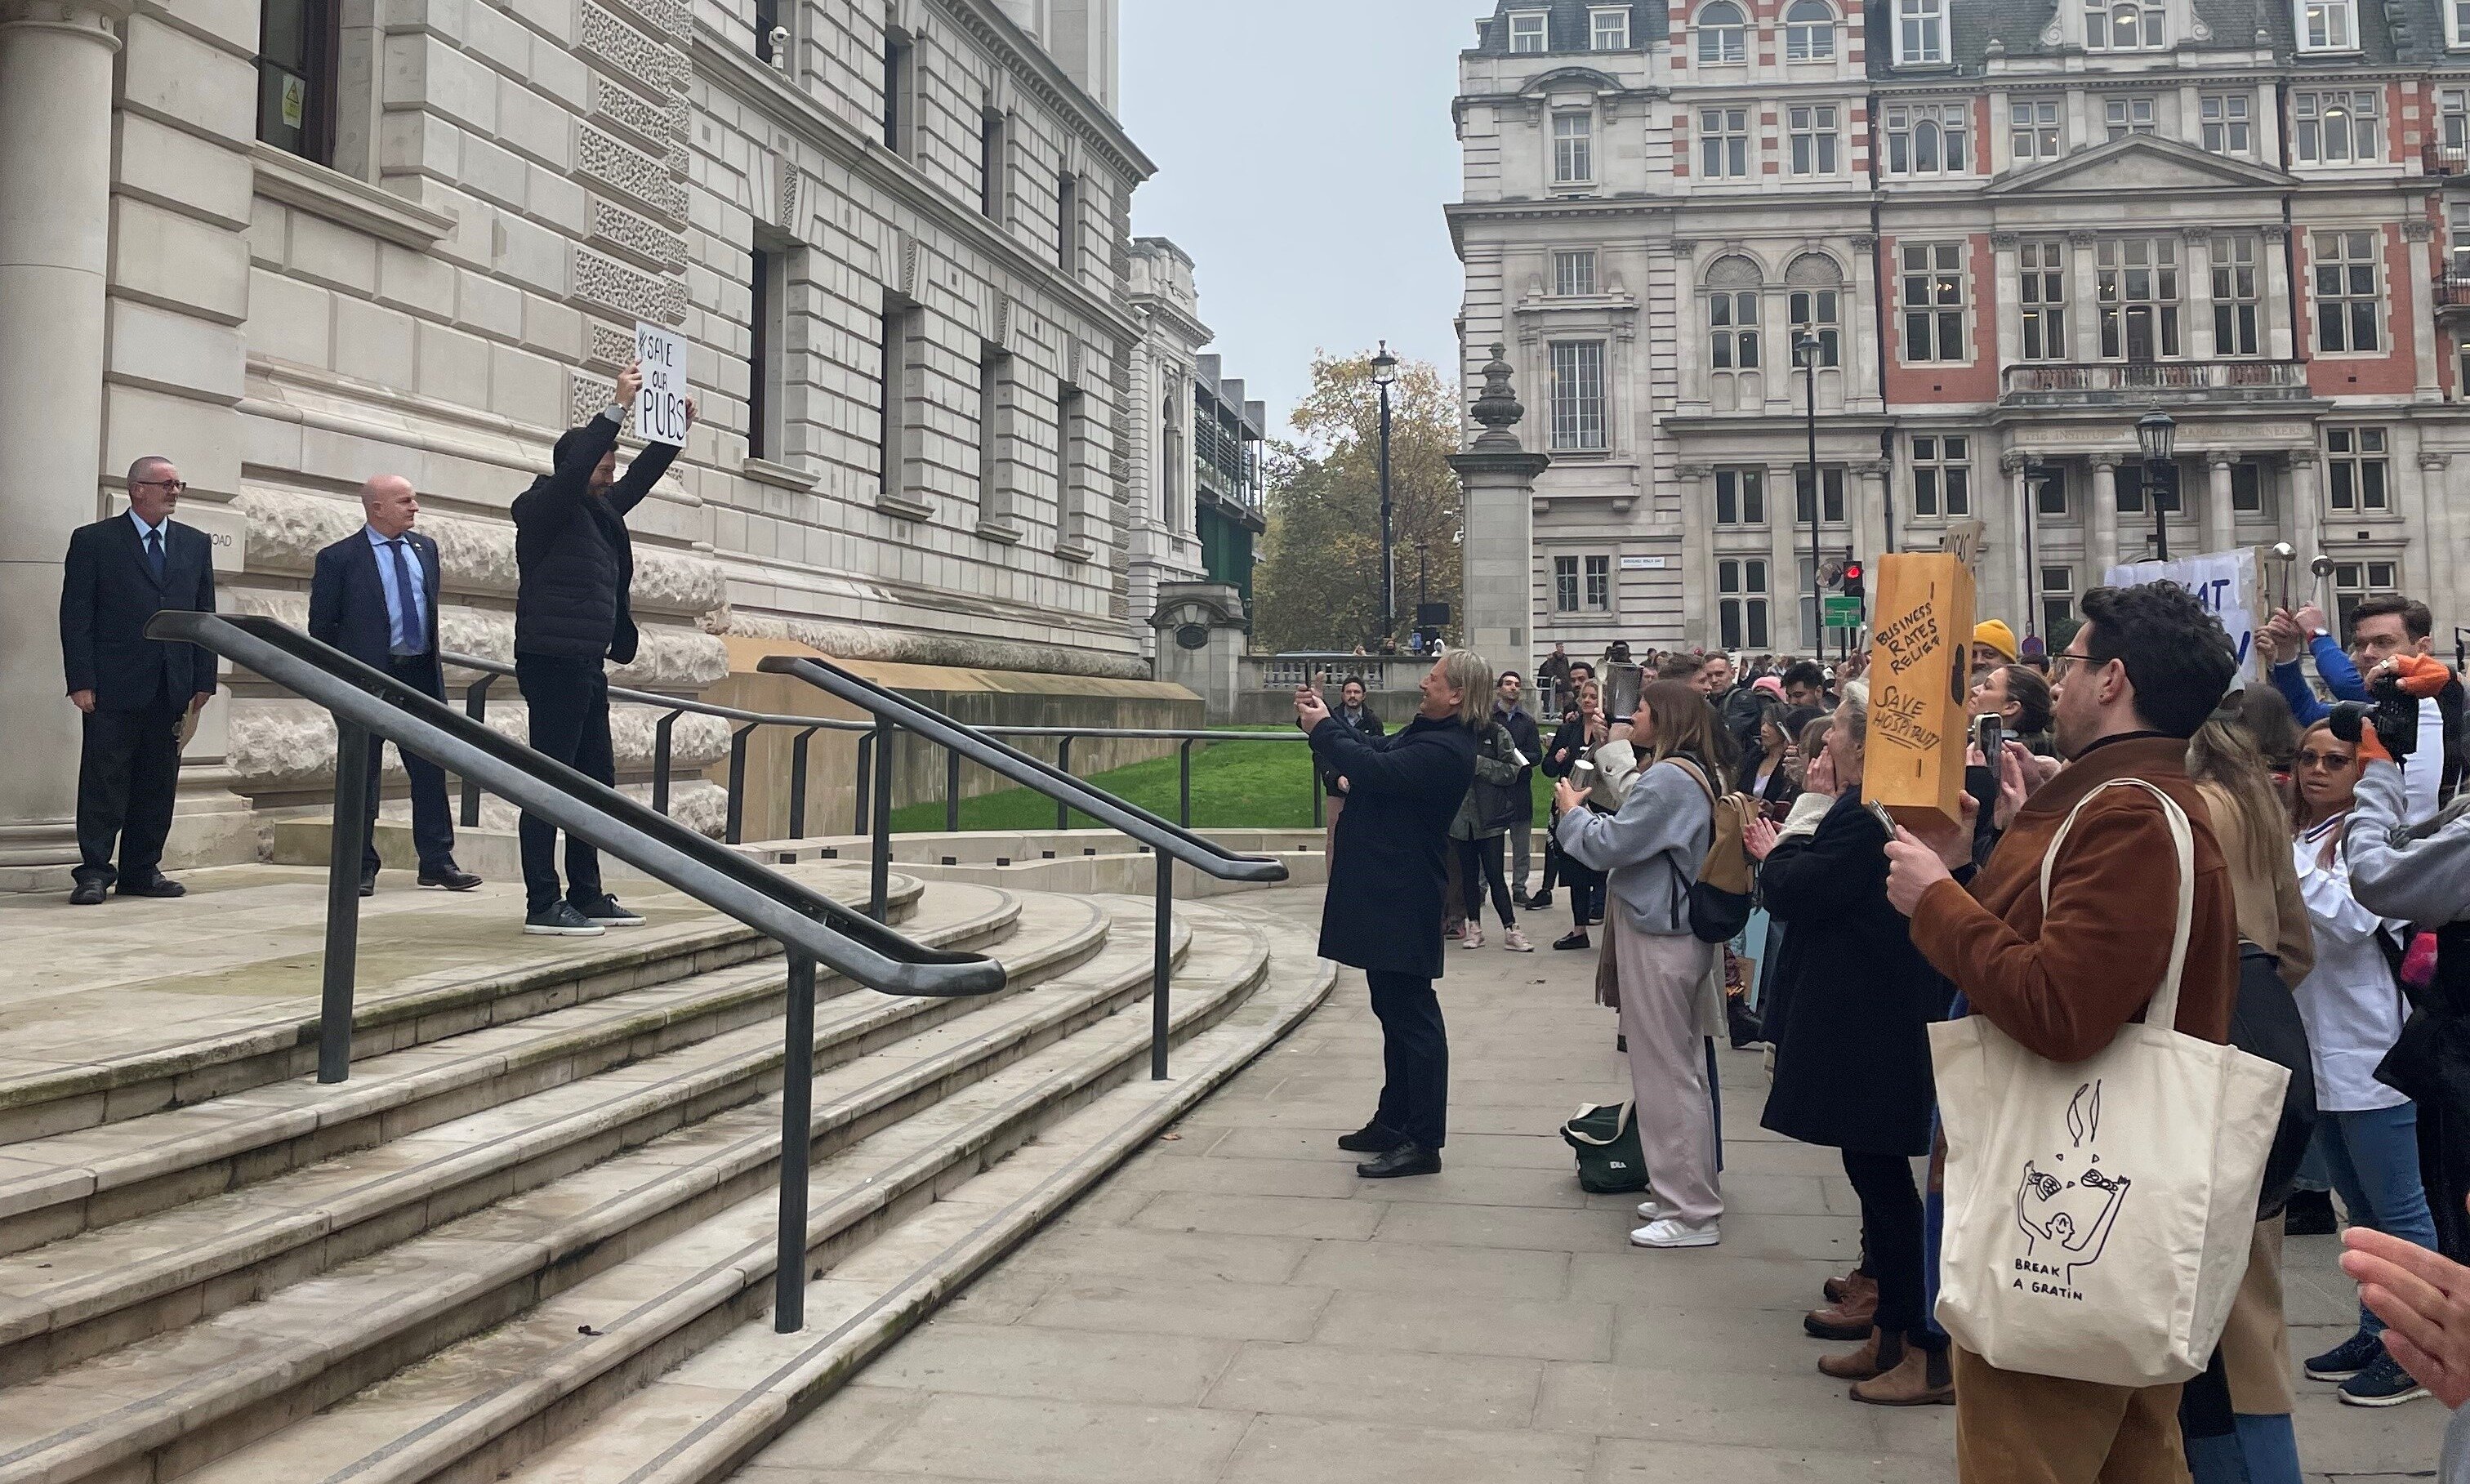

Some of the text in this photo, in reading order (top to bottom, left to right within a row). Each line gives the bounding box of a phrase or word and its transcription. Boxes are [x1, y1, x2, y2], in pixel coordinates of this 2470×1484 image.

[652, 370, 668, 391] OUR
[644, 388, 685, 441] PUBS
[212, 534, 231, 546] OAD
[2187, 578, 2231, 612] AT
[1876, 602, 1933, 646] BUSINESS
[1888, 617, 1938, 657] RATES
[1891, 635, 1940, 675] RELIEF
[1875, 685, 1927, 716] SAVE
[1873, 712, 1940, 751] HOSPITALITY
[2013, 1277, 2023, 1290] A
[2015, 1259, 2060, 1277] BREAK
